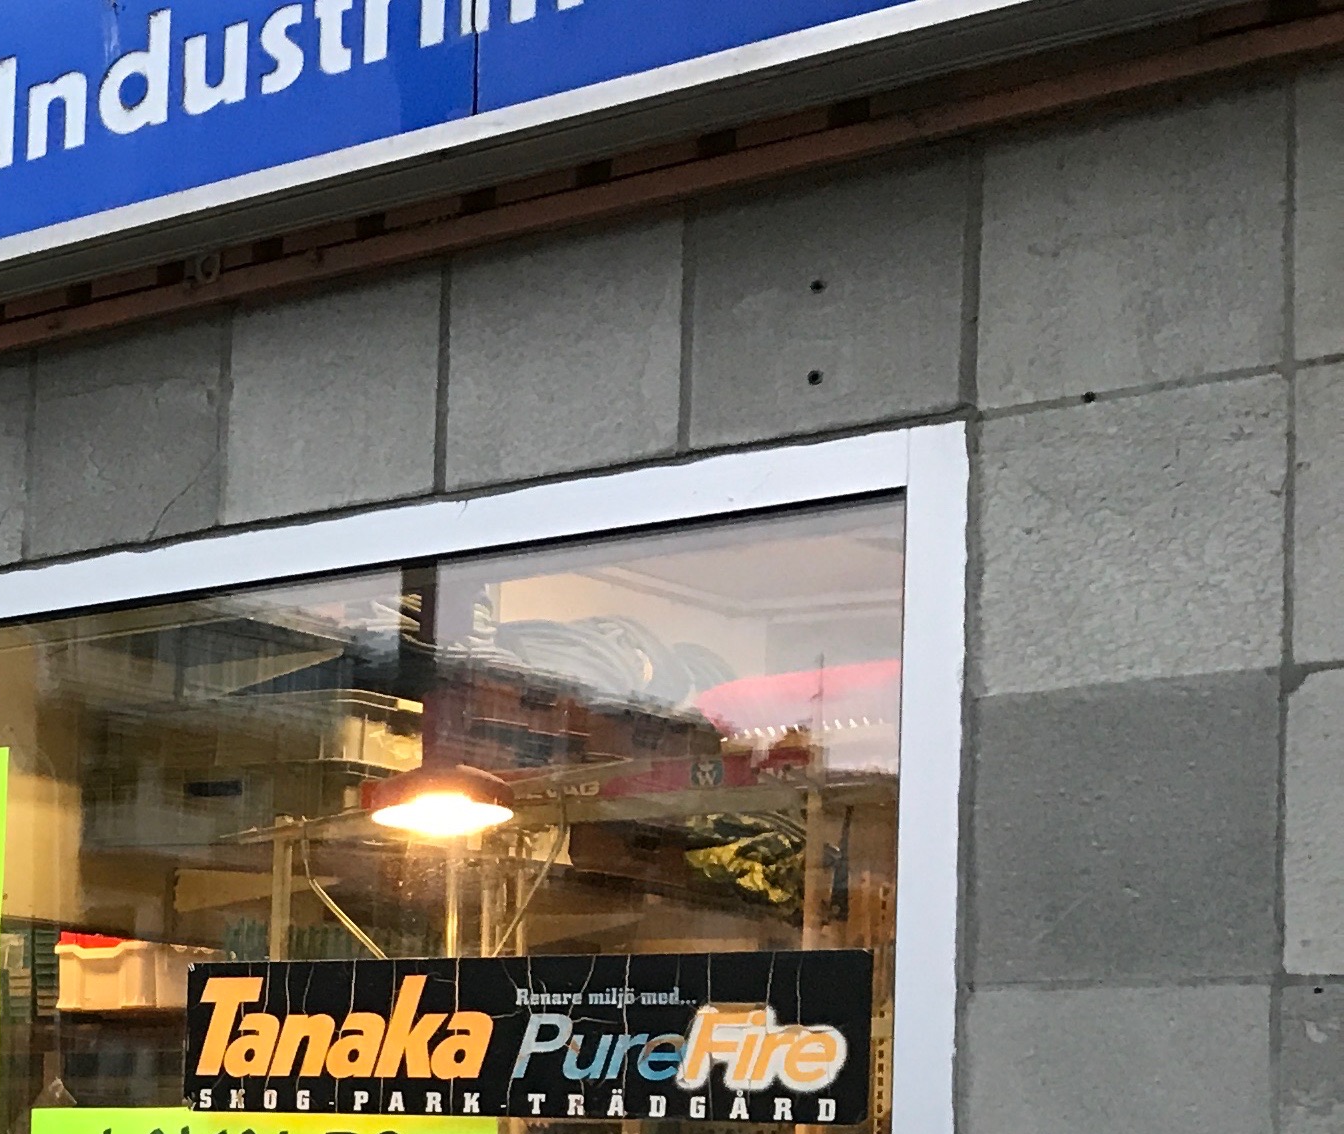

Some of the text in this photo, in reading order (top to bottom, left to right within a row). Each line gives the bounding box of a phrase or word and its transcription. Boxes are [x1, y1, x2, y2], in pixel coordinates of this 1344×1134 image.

[515, 987, 583, 1006] Renare
[195, 974, 494, 1081] Tanaka
[199, 1088, 311, 1110] SKOG
[353, 1090, 481, 1114] PARK
[527, 1088, 837, 1122] TRÄDGÅRD
